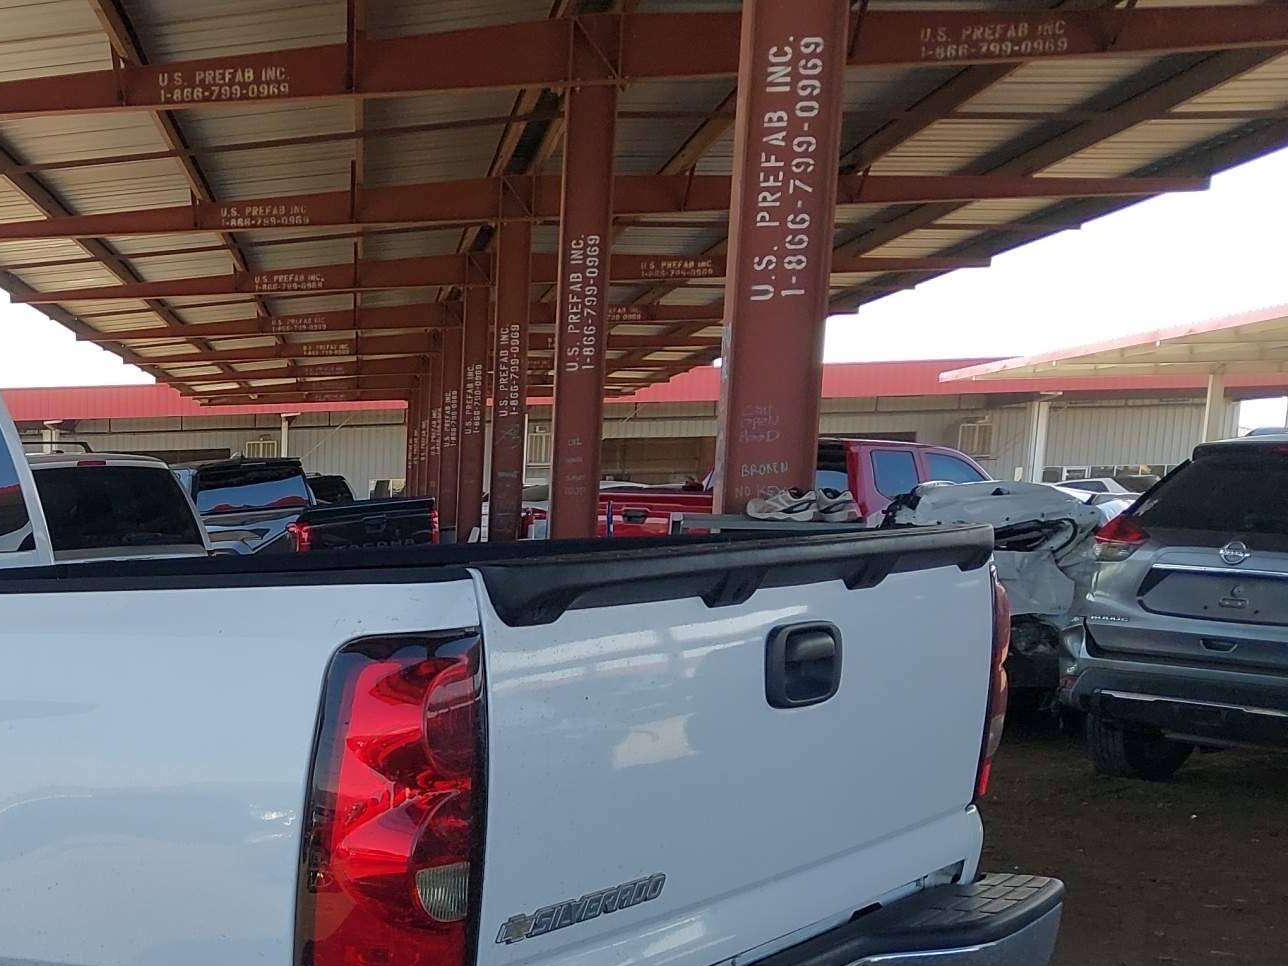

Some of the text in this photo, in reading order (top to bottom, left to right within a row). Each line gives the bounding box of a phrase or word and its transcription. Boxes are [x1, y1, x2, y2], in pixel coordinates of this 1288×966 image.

[920, 27, 951, 42] U.S.
[962, 23, 1028, 41] PREFAB
[920, 38, 1068, 60] 1-866-799-0969
[158, 67, 290, 86] U.S. PREFAB INC.
[161, 83, 289, 102] 1-866-799-0969
[750, 36, 794, 300] U.S. PREFAB INC.
[780, 36, 824, 296] 1-866-799-0969
[220, 207, 240, 218] U.S.
[245, 205, 286, 217] PREFAB
[273, 273, 305, 283] PREFAB
[565, 234, 585, 372] U.S. PREFAB INC.
[582, 235, 600, 369] 1-866-799-0969
[498, 323, 510, 417] U.S. PREFAB INC.
[465, 382, 474, 415] PREFAB
[741, 461, 789, 478] BROKEN
[526, 872, 666, 938] SILVERADO
